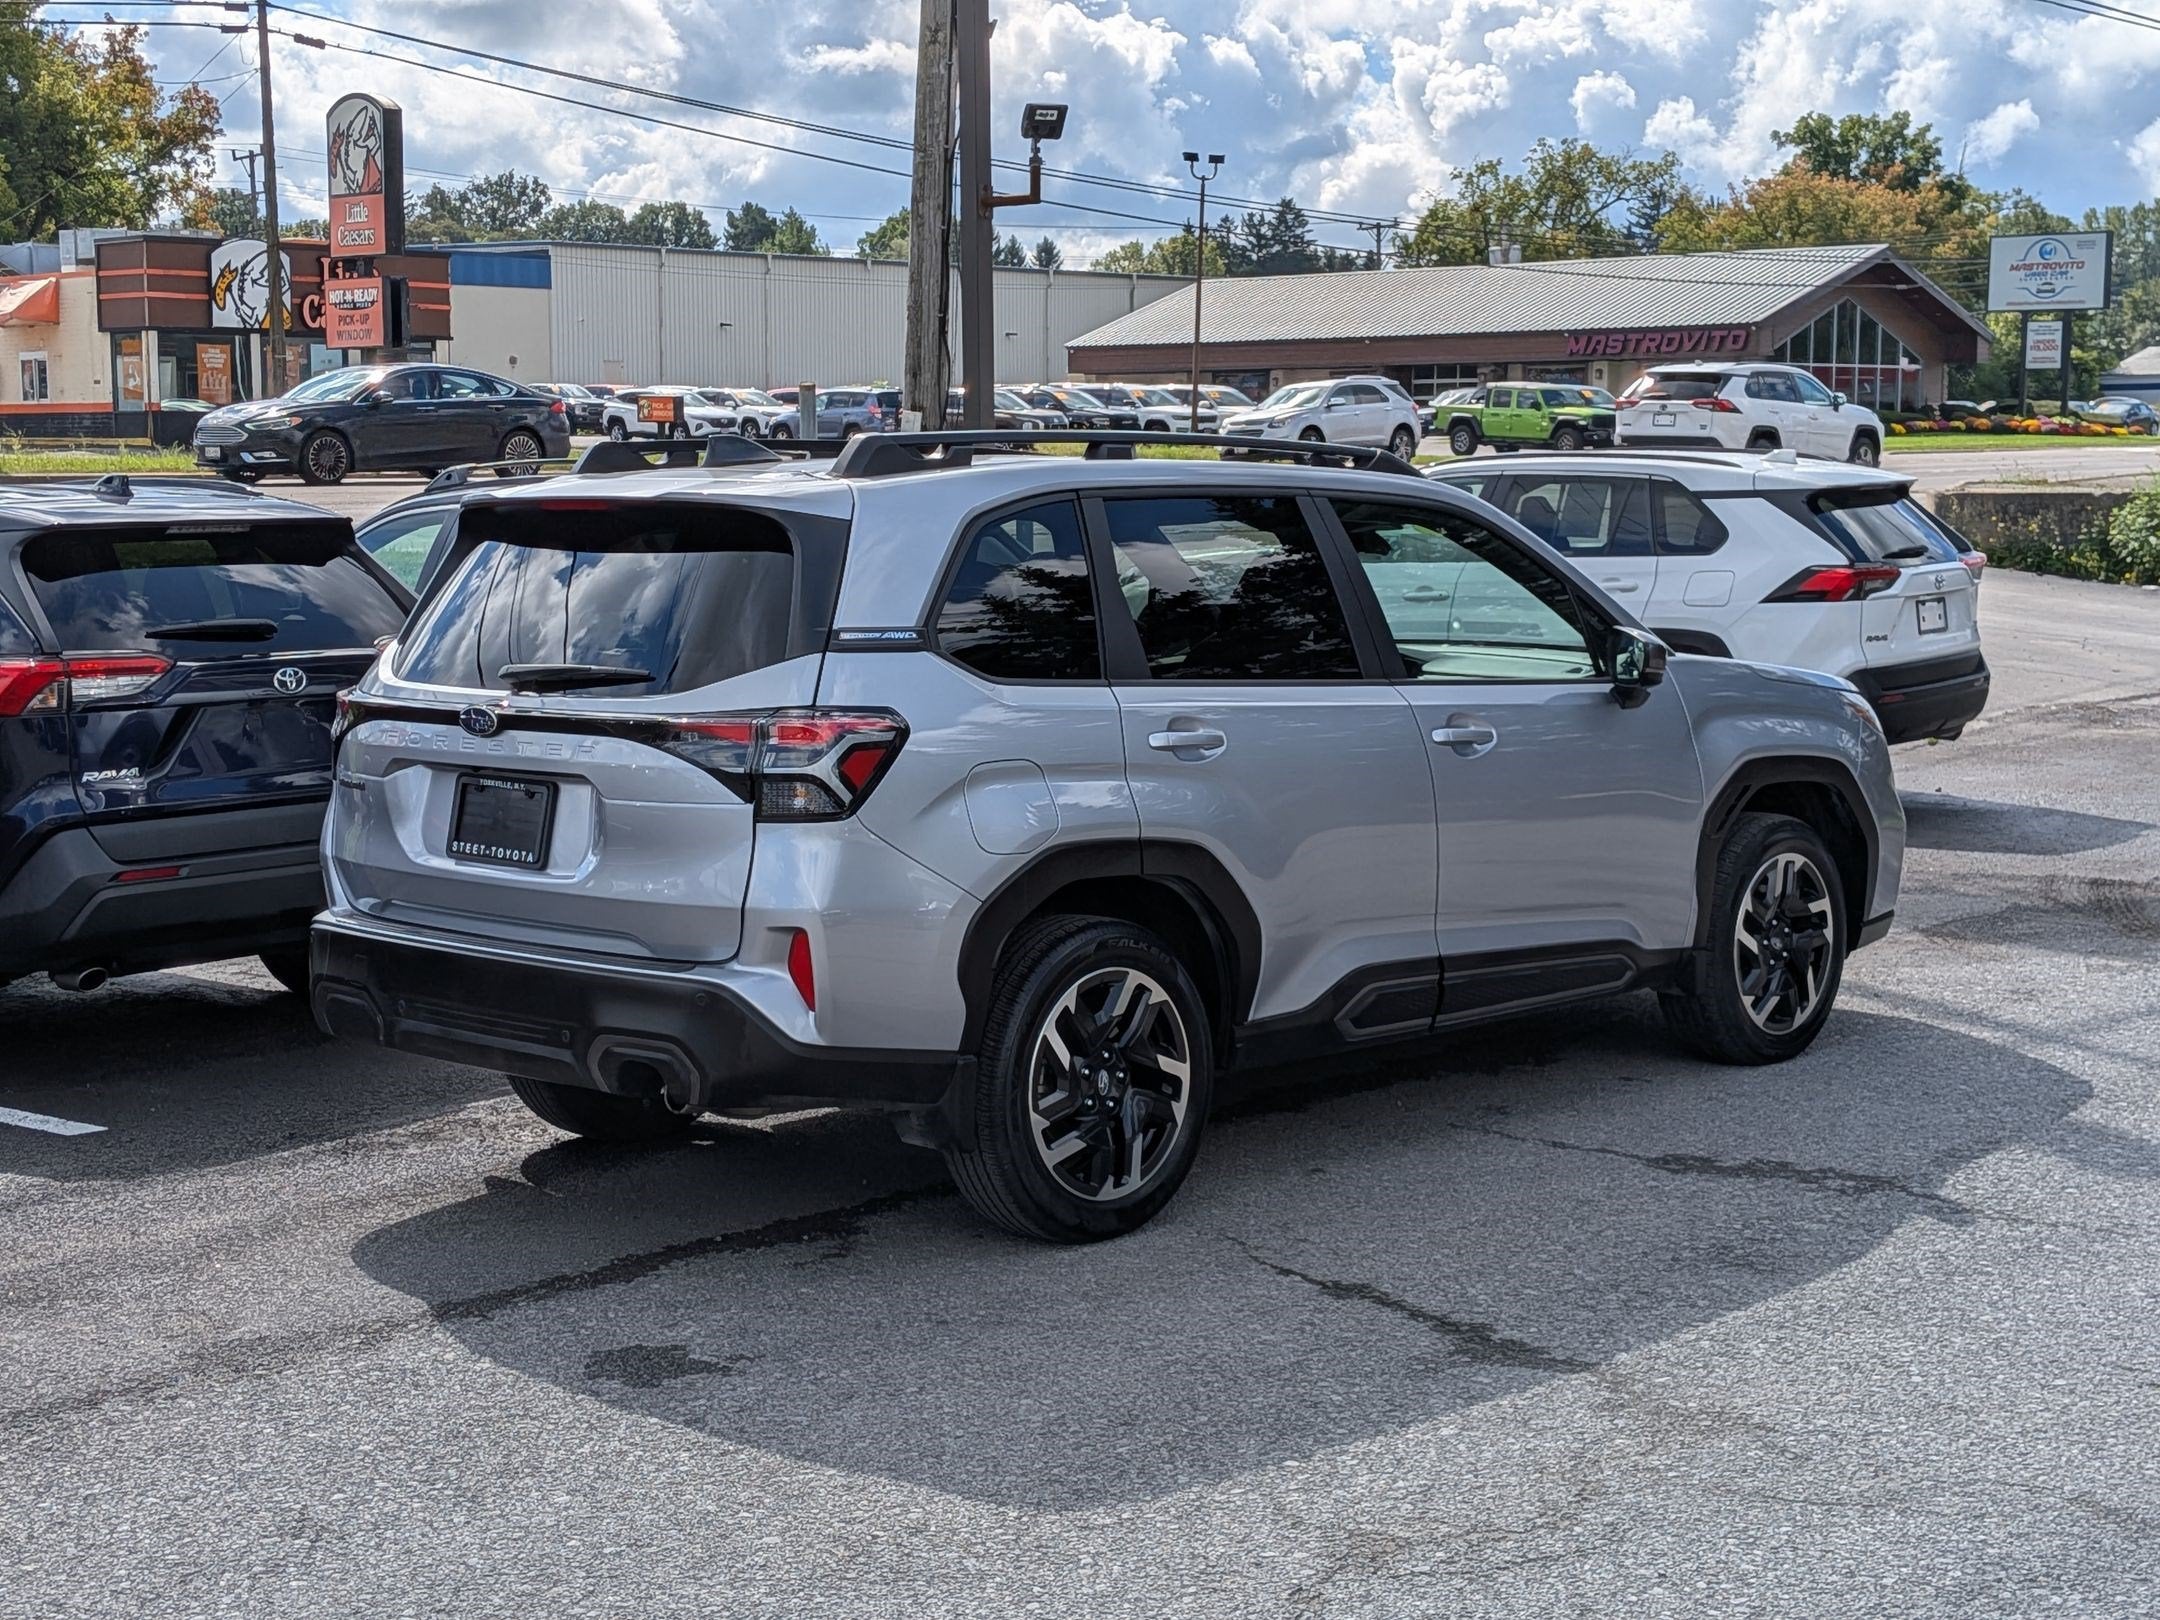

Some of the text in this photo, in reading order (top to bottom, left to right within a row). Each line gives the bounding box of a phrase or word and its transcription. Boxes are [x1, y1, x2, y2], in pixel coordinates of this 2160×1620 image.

[345, 202, 368, 223] Little
[337, 226, 376, 247] Caesars
[2009, 261, 2085, 272] MASTROVITO
[328, 288, 378, 303] HOT-N-READY
[338, 313, 370, 327] PICK-UP
[336, 328, 373, 341] WINDOW
[1567, 328, 1750, 356] MASTROVITO
[383, 728, 597, 761] FORESTER
[81, 766, 140, 784] RAV4
